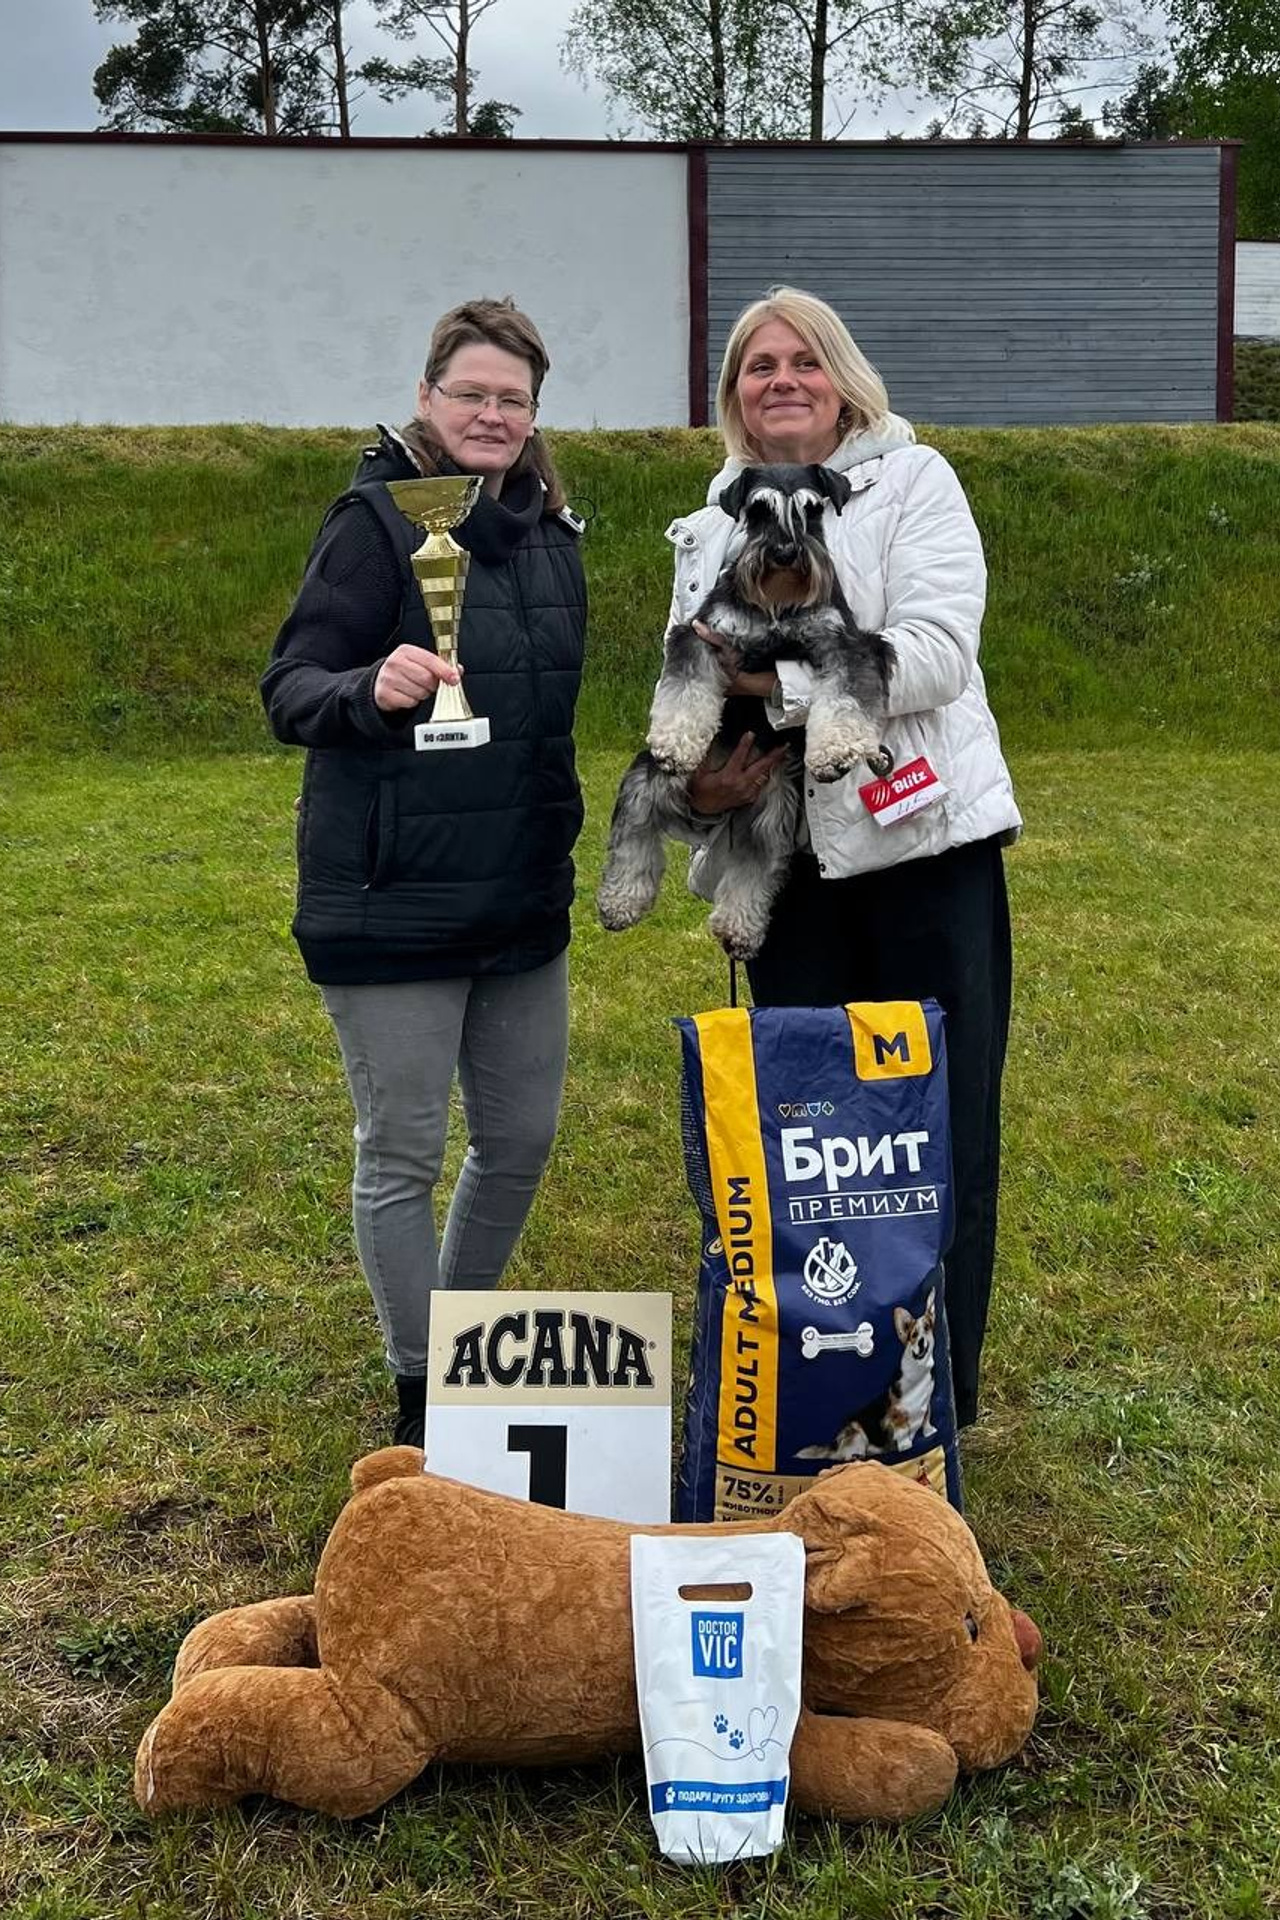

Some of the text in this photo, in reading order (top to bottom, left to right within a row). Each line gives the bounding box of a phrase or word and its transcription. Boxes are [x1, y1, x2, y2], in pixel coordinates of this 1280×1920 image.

[891, 771, 928, 794] Blitz
[873, 1032, 911, 1065] M
[780, 1126, 929, 1192] Брит
[788, 1190, 939, 1221] ПРЕМИУМ
[727, 1177, 761, 1459] ADULT MEDIUM
[443, 1308, 655, 1388] ACANA
[507, 1424, 568, 1511] 1
[723, 1475, 774, 1504] 75%
[698, 1620, 737, 1635] DOCTOR
[699, 1634, 737, 1668] VIC
[678, 1790, 712, 1803] ПОДАРИ
[712, 1791, 734, 1804] ДРУГУ
